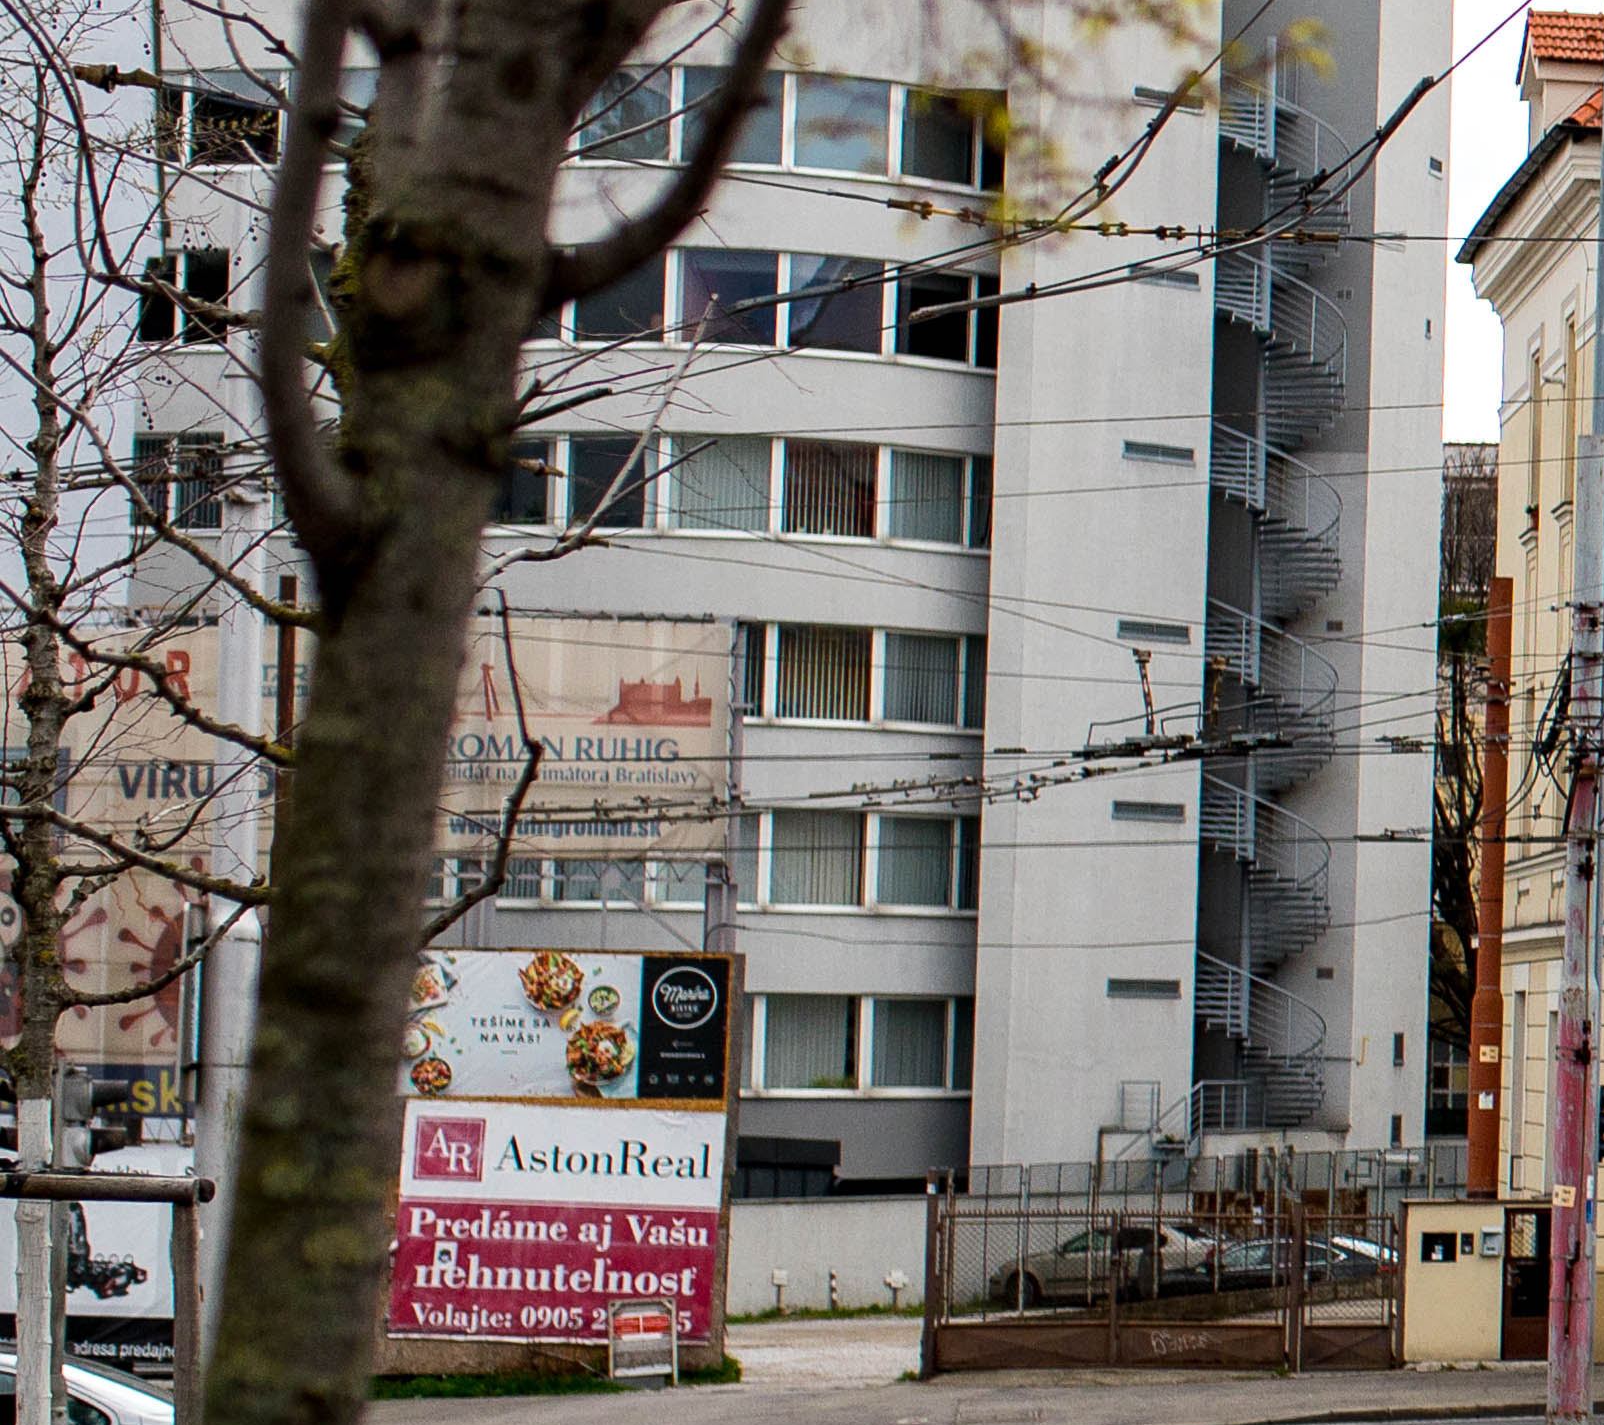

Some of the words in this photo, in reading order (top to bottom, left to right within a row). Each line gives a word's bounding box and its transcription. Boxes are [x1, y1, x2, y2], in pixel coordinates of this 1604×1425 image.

[575, 737, 679, 762] RUHIG
[615, 768, 697, 787] Bratislavy
[533, 1016, 551, 1029] SA
[480, 1032, 500, 1044] NA
[494, 1133, 712, 1180] AstonReal
[409, 1207, 568, 1242] Predáme
[578, 1214, 613, 1251] aj
[626, 1214, 709, 1247] Vašu
[414, 1255, 697, 1296] nehnuteľnosť
[411, 1301, 512, 1334] Volajte:
[520, 1305, 583, 1330] 0905
